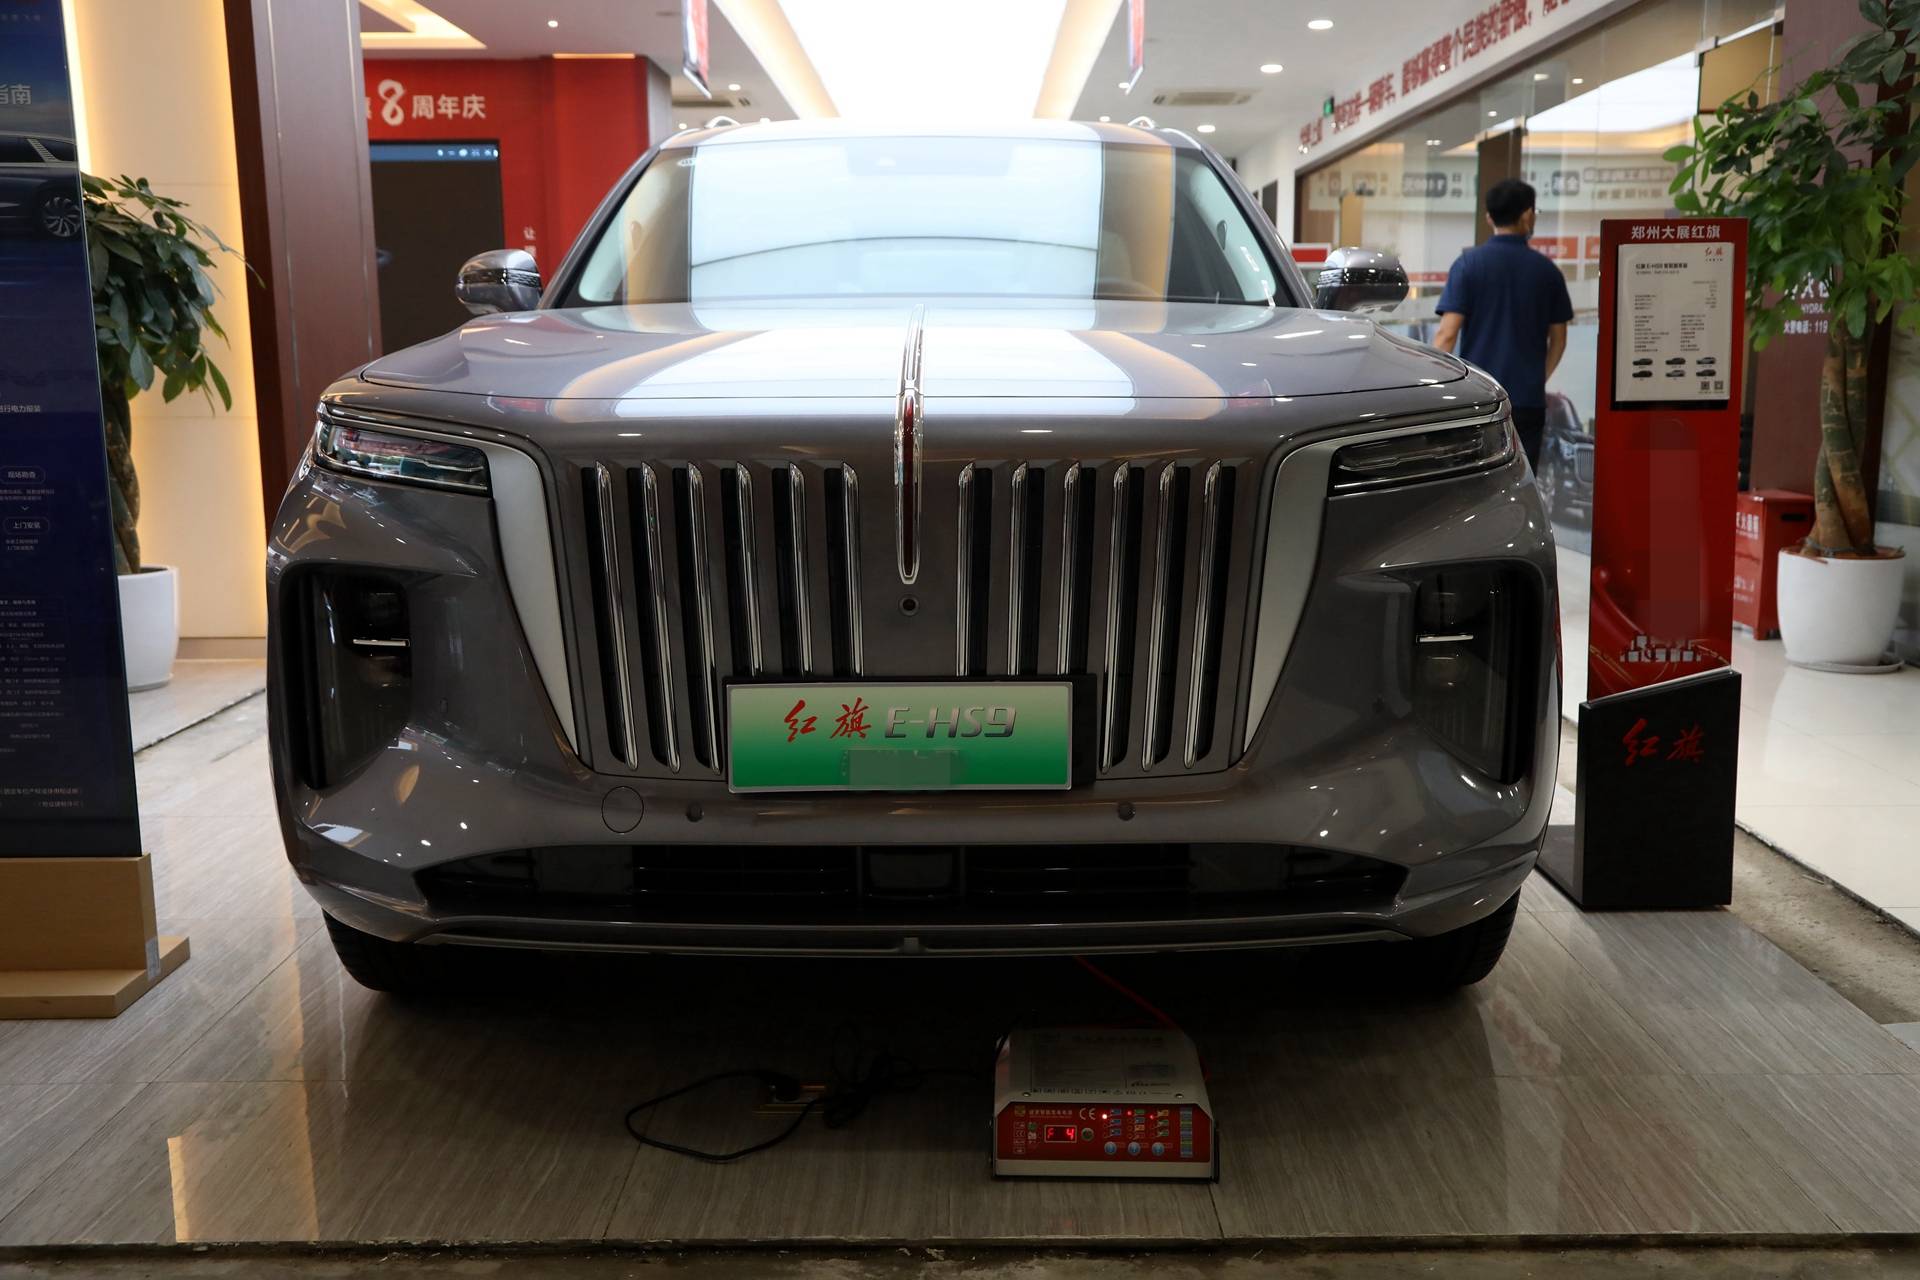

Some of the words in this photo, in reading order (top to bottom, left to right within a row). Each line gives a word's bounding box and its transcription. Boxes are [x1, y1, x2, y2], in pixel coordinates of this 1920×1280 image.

[366, 79, 487, 127] 8周年庆
[1631, 225, 1721, 240] 郑州大展红旗
[784, 697, 872, 743] 红旗
[885, 705, 1017, 738] E-HS9
[1623, 718, 1704, 766] 红旗
